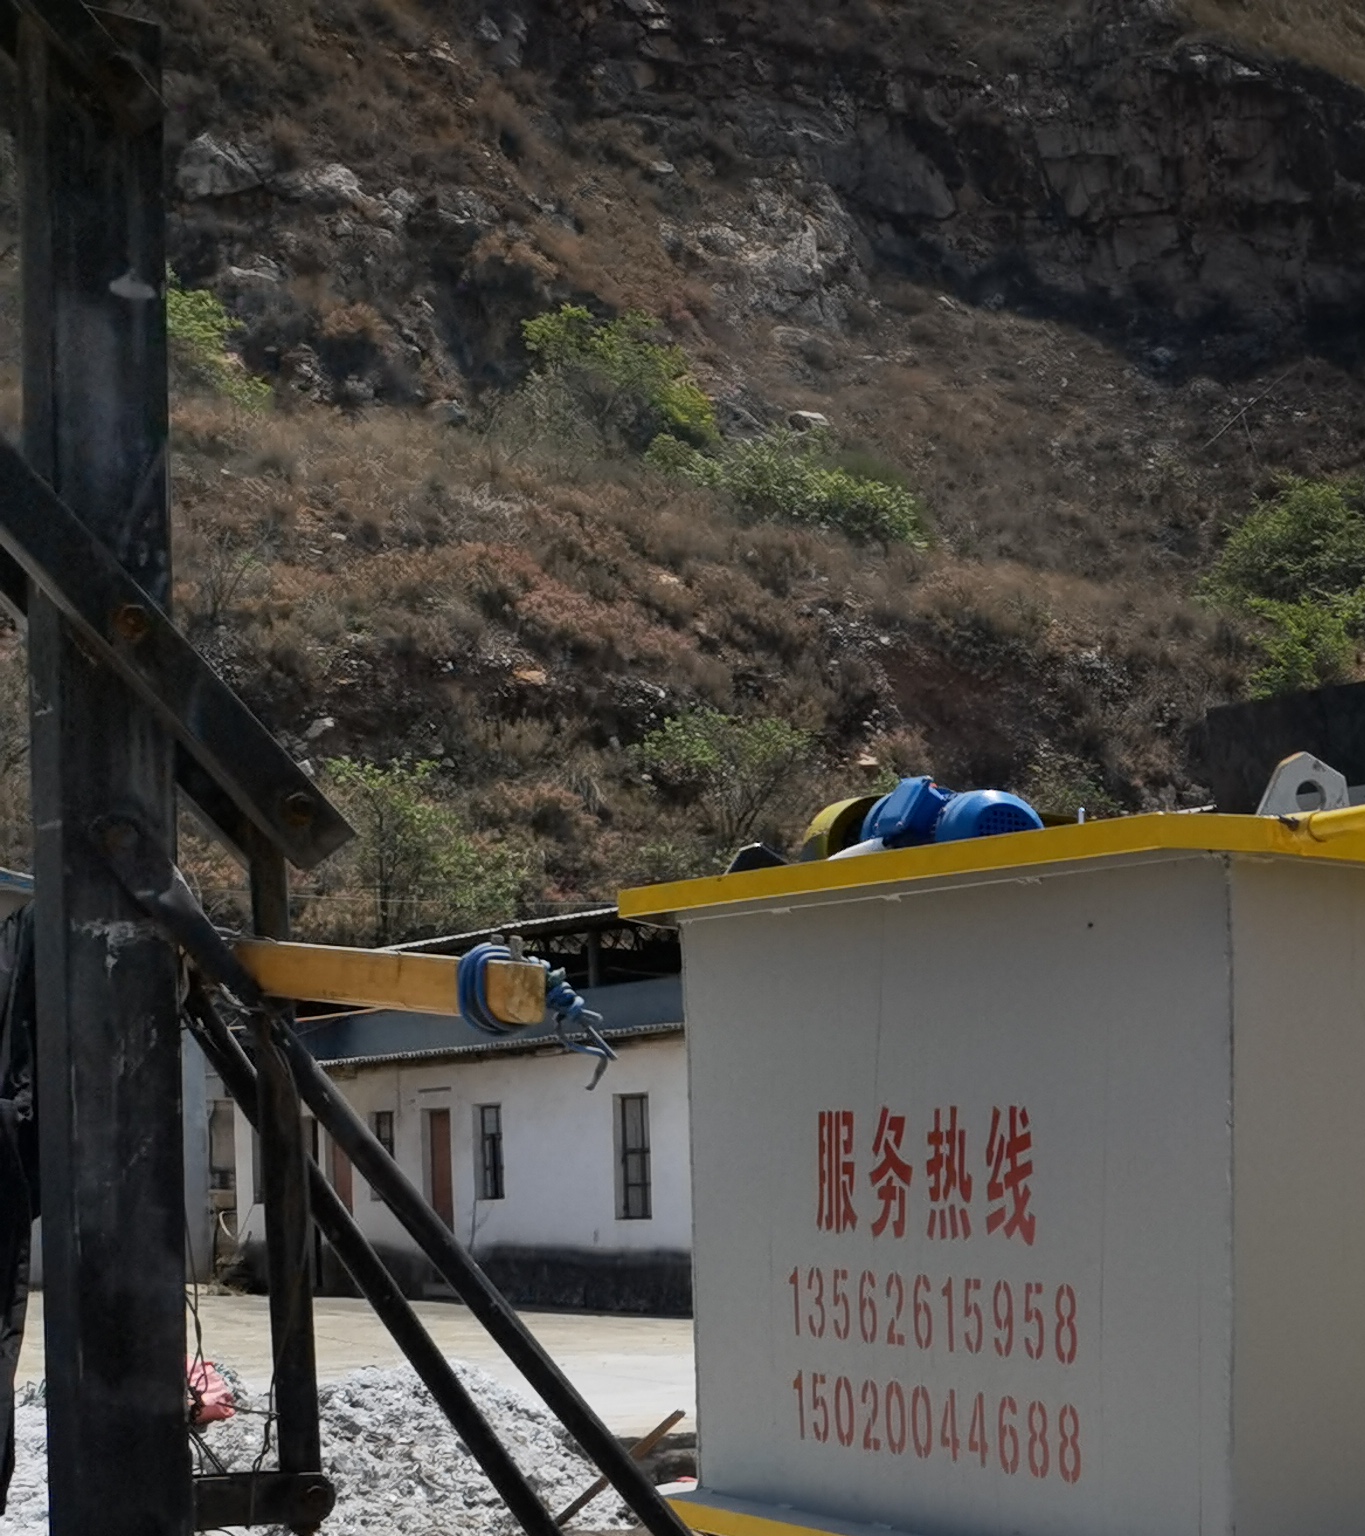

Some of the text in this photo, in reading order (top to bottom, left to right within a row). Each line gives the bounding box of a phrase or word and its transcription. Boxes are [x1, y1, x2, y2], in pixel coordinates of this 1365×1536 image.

[816, 1105, 1037, 1246] 服务热线
[788, 1266, 1079, 1365] 13562615958
[792, 1370, 1082, 1484] 15020044688
